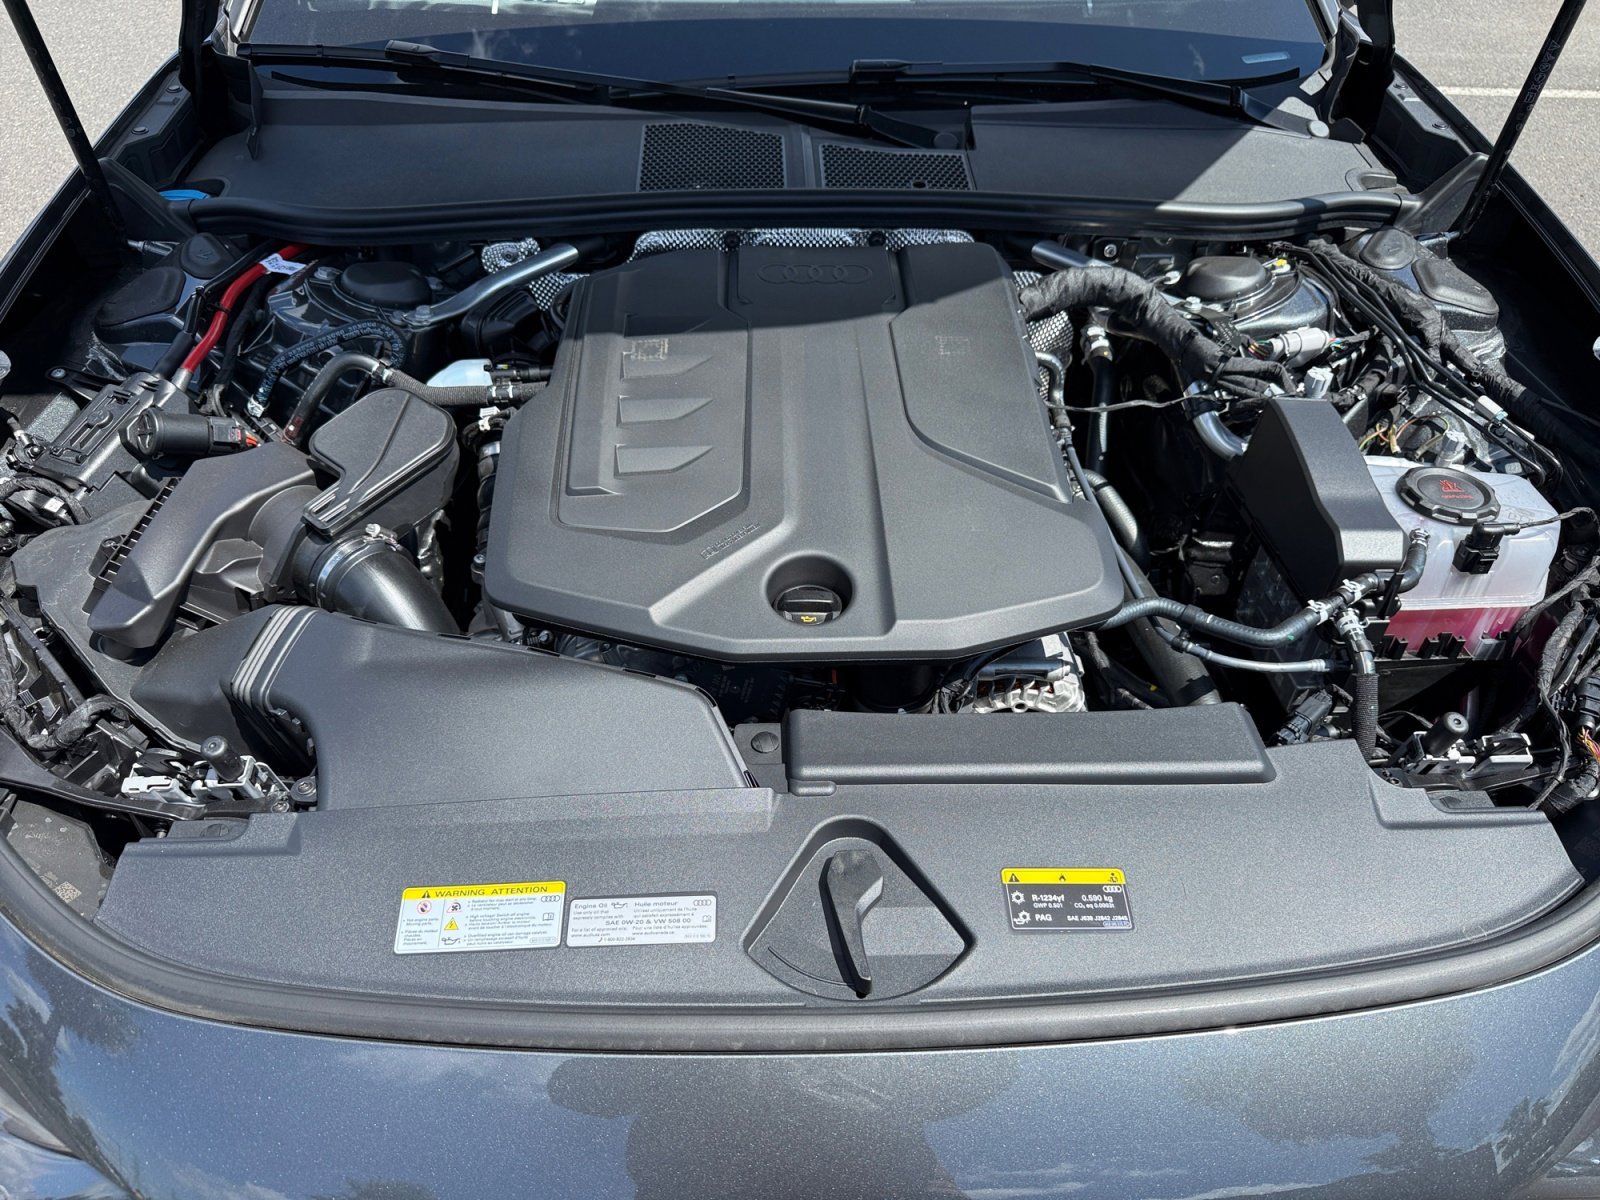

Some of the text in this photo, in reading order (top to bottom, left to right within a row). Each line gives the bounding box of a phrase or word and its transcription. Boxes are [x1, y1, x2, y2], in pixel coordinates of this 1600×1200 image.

[435, 886, 548, 897] WARNING ATTENTION
[1103, 894, 1114, 902] kg
